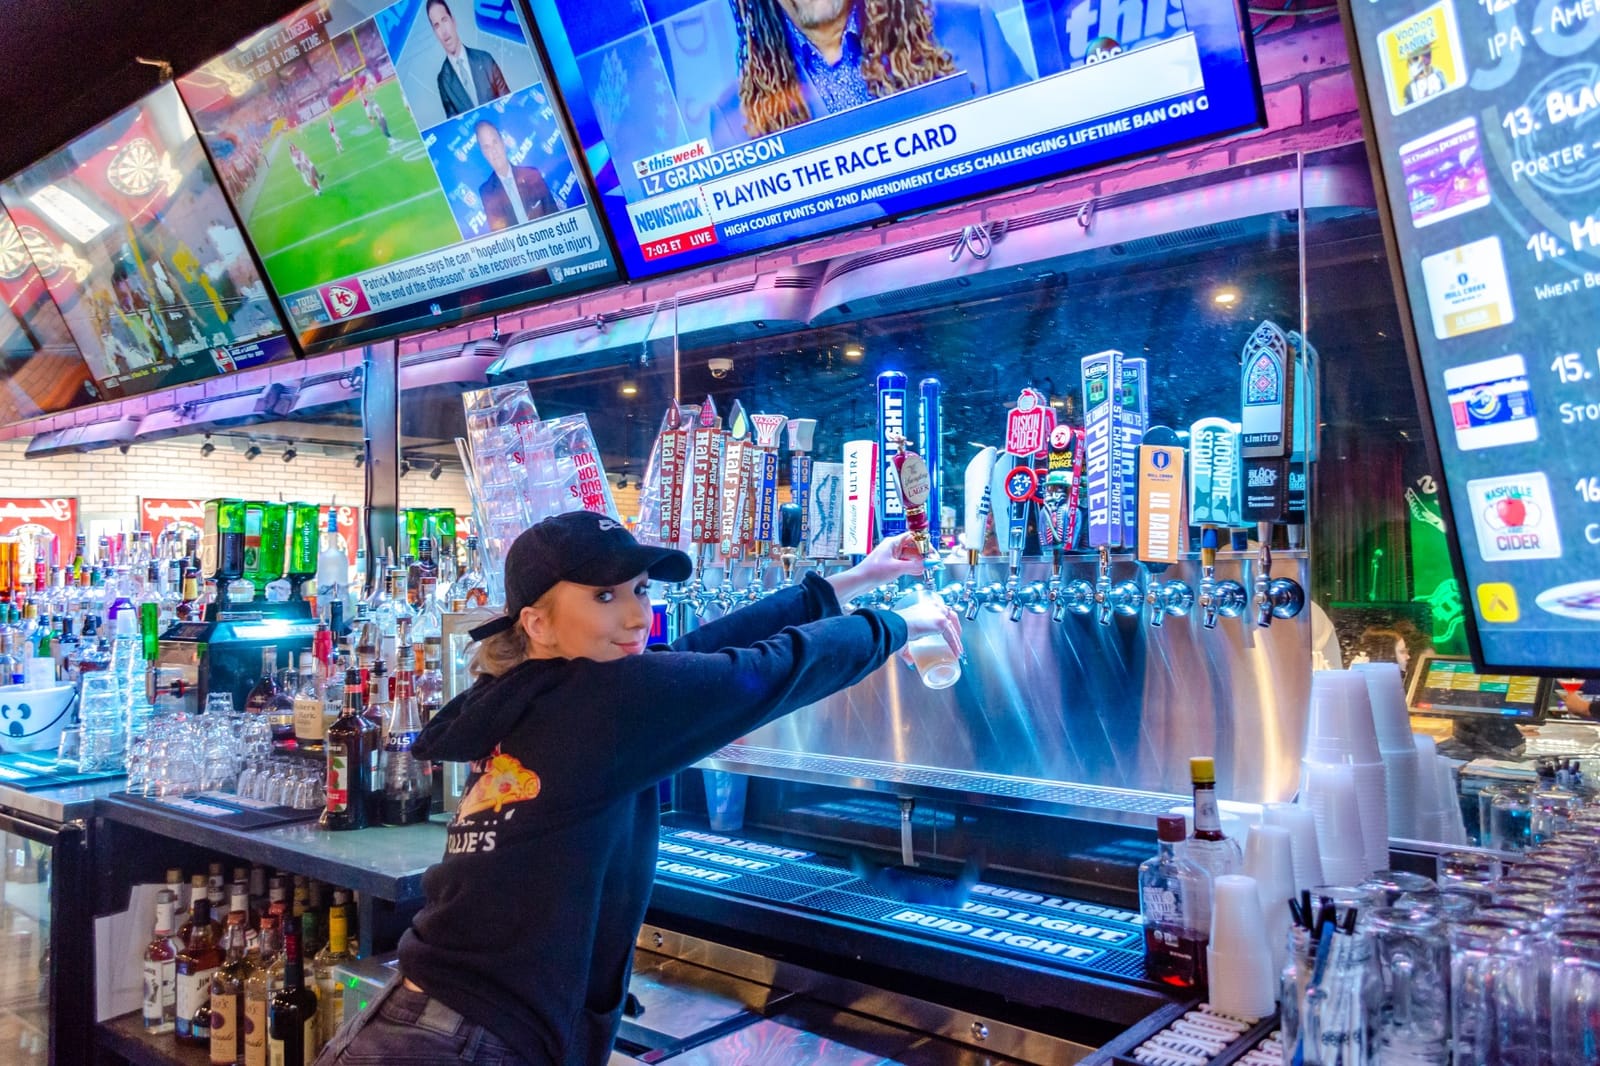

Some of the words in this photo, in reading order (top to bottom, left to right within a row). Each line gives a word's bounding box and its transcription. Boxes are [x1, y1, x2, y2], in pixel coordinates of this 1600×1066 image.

[1487, 25, 1526, 60] IPA
[1550, 0, 1600, 33] AME
[279, 46, 300, 65] LONG
[1411, 80, 1443, 102] IPA
[1502, 106, 1543, 139] 13.
[642, 176, 661, 196] LZ
[665, 136, 786, 189] GRANDERSON
[713, 174, 792, 211] PLAYING
[793, 159, 834, 188] THE
[838, 140, 893, 177] RACE
[894, 122, 958, 159] CARD
[724, 221, 750, 238] HIGH
[749, 214, 783, 231] COURT
[782, 205, 817, 222] PUNTS
[817, 199, 835, 213] ON
[836, 192, 859, 208] 2ND
[860, 171, 934, 201] AMENDMENT
[933, 160, 974, 181] CASES
[974, 134, 1068, 171] CHALLENGING
[1069, 117, 1133, 147] LIFETIME
[1133, 108, 1167, 129] BAN
[1167, 100, 1196, 120] ON
[1511, 142, 1585, 183] PORTER
[468, 210, 488, 235] FIL
[362, 270, 390, 291] Patrick
[389, 264, 426, 286] Mahomes
[425, 260, 445, 277] says
[444, 255, 456, 269] he
[455, 252, 473, 265] can
[471, 236, 517, 260] "hopefully
[516, 232, 530, 247] do
[529, 228, 556, 245] some
[555, 216, 580, 239] stuff
[645, 243, 669, 258] 7:02
[670, 238, 682, 251] ET
[689, 230, 712, 248] LIVE
[1526, 231, 1566, 262] 14.
[370, 291, 380, 306] by
[378, 288, 392, 301] the
[391, 285, 405, 299] end
[403, 283, 414, 296] of
[413, 279, 427, 294] the
[466, 265, 479, 279] as
[479, 260, 491, 276] he
[490, 251, 528, 274] recovers
[527, 246, 550, 263] from
[548, 241, 564, 257] toe
[563, 233, 593, 255] injury
[1534, 279, 1581, 300] WHEAT
[1551, 353, 1593, 384] 15.
[1012, 413, 1040, 433] DISKIN
[1559, 401, 1600, 425] STO
[1010, 430, 1038, 450] CIDER
[1111, 423, 1122, 479] CHARLES
[1193, 430, 1214, 477] STOUT
[570, 451, 596, 468] YOU.
[577, 466, 599, 481] FOR
[766, 455, 775, 481] DOS
[849, 451, 858, 494] ULTRA
[1085, 408, 1110, 528] PORTER
[1212, 431, 1233, 503] MOONPIE
[1247, 466, 1278, 480] BLACK
[570, 479, 603, 499] BUD'S
[1111, 480, 1121, 526] PORTER
[1484, 485, 1533, 502] NASHVILLE
[761, 487, 773, 540] PERROS
[1147, 512, 1171, 560] DARLIN
[1496, 534, 1541, 552] CIDER
[389, 736, 411, 746] OLS
[674, 830, 731, 845] BUD
[729, 840, 808, 859] LIGHT
[656, 860, 733, 883] LIGHT
[693, 850, 773, 870] LIGHT
[972, 884, 1044, 904] BUD
[1041, 898, 1143, 925] LIGHT
[893, 911, 974, 935] BUD
[969, 927, 1096, 960] LIGHT
[1006, 912, 1128, 942] LIGHT
